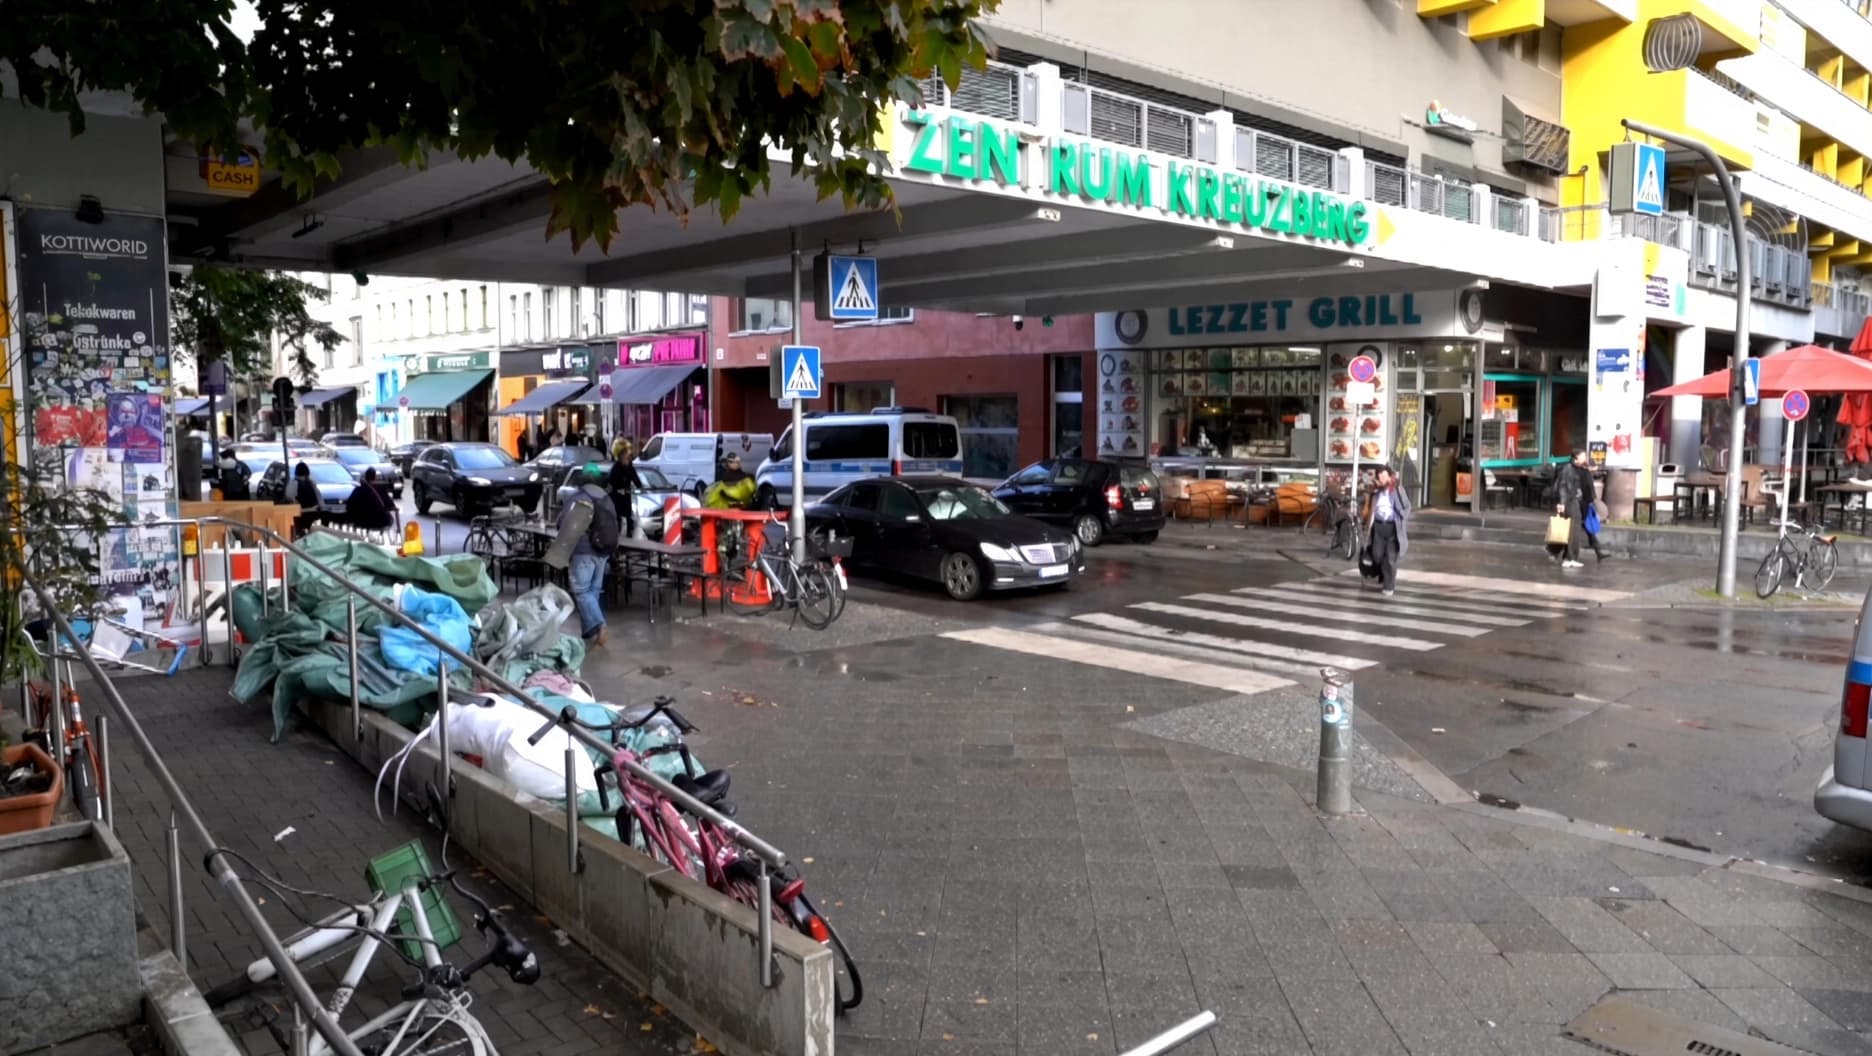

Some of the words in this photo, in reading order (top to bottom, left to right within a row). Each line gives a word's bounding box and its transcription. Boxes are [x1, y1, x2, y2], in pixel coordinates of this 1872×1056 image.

[212, 170, 254, 185] CASH
[1169, 300, 1293, 336] LEZZET
[1309, 293, 1422, 329] GRILL
